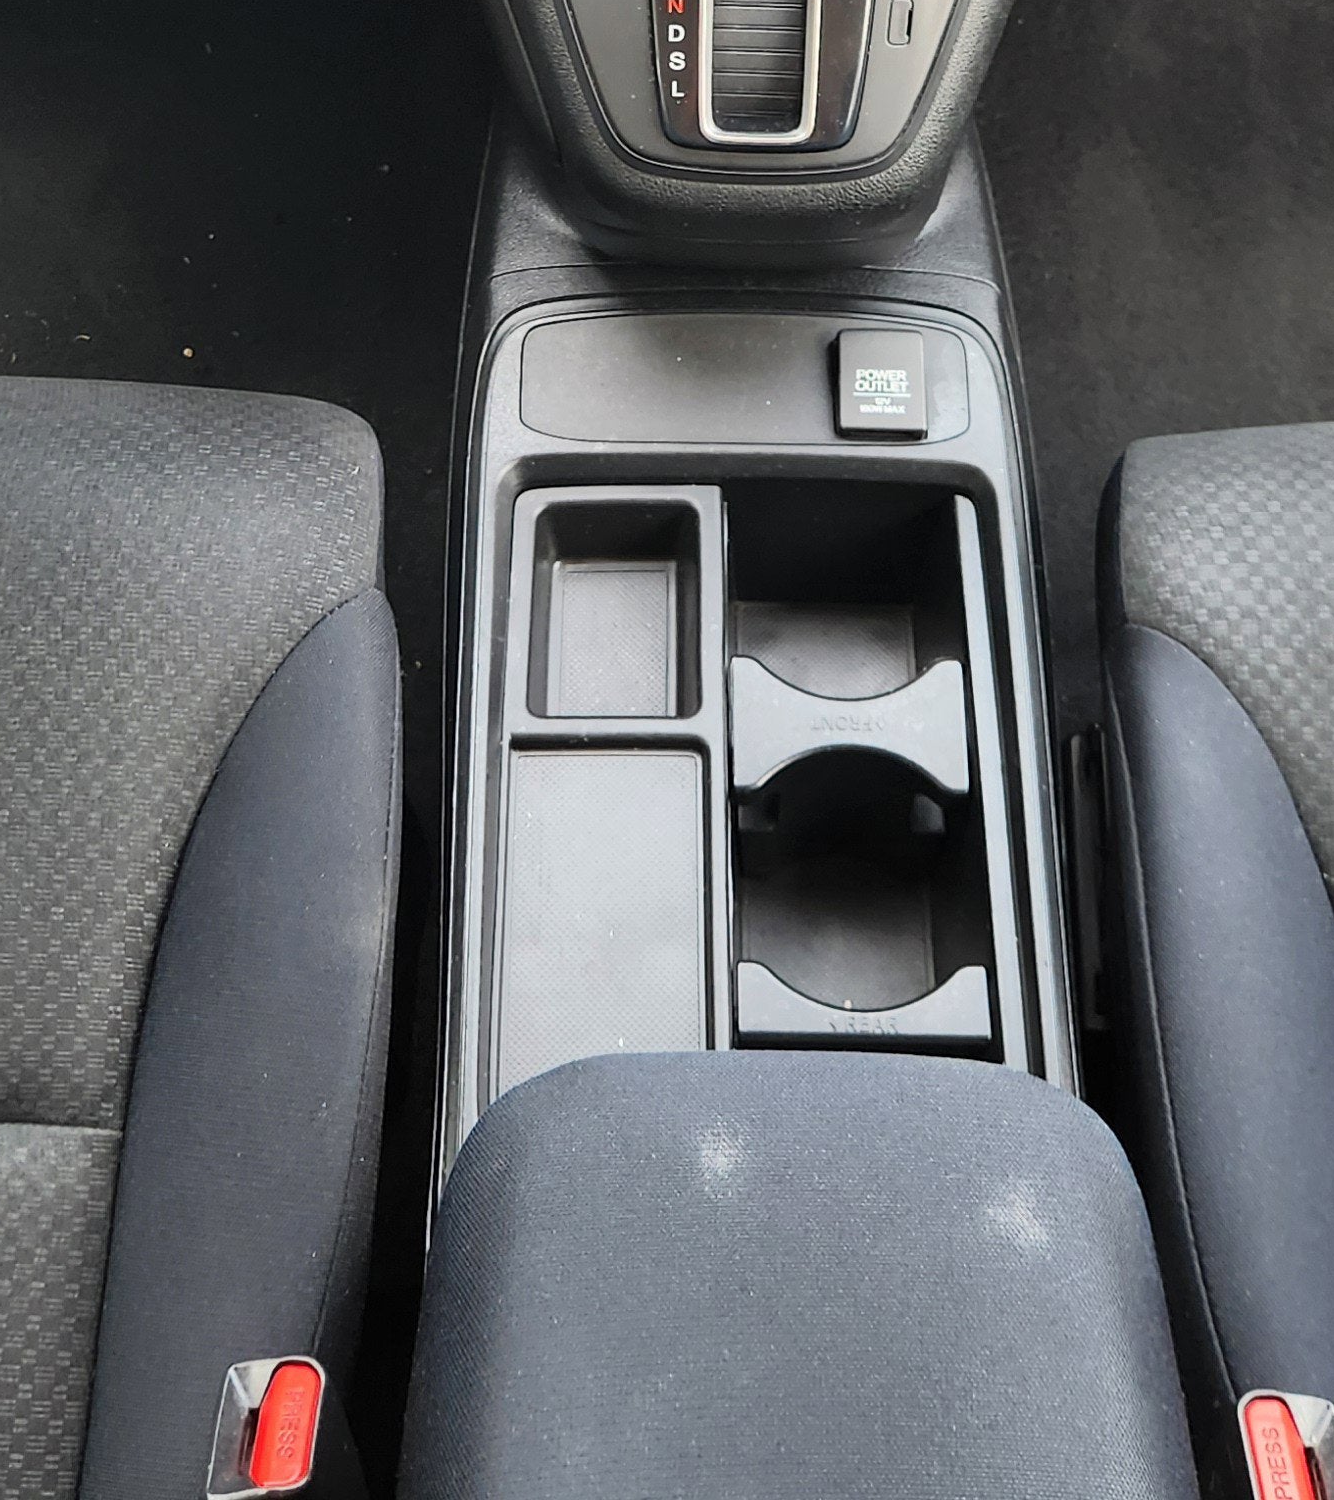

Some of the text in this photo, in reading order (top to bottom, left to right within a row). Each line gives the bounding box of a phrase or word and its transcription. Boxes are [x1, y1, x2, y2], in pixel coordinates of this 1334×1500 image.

[668, 24, 686, 43] D
[669, 51, 687, 71] S
[671, 80, 685, 98] L
[856, 368, 907, 381] POWER
[854, 380, 909, 393] OUTLET
[276, 1386, 306, 1459] PRESS
